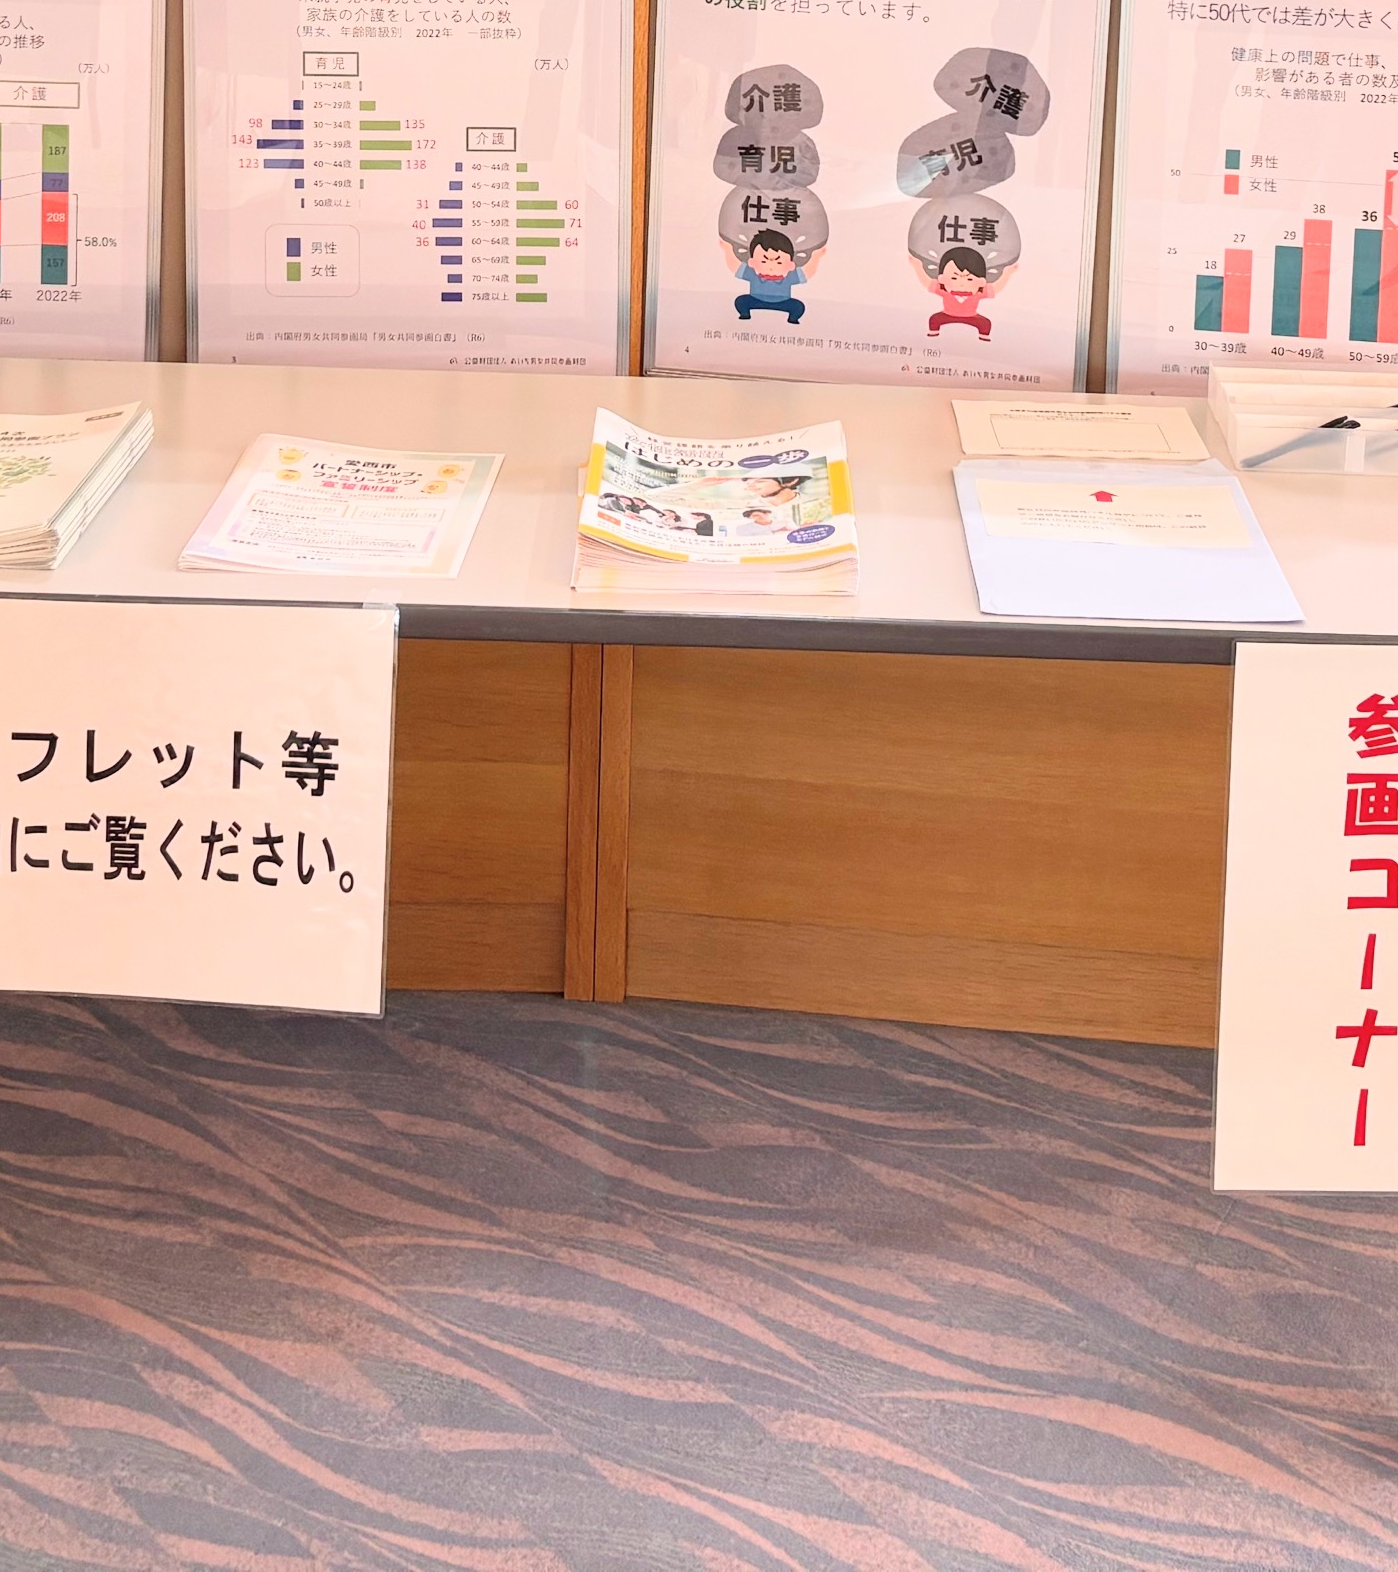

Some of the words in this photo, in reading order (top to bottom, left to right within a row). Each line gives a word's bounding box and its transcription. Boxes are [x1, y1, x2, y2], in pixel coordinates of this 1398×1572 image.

[307, 7, 512, 25] 家族の介護をしている人の数
[315, 57, 345, 70] 育児
[13, 85, 47, 103] 介護
[742, 83, 803, 113] 介護
[965, 73, 1030, 120] 介護
[249, 119, 262, 128] 98
[405, 120, 425, 129] 135
[232, 135, 253, 145] 143
[416, 140, 436, 149] 172
[475, 131, 505, 146] 介護
[738, 145, 797, 175] 育児
[919, 137, 983, 179] 育児
[1250, 155, 1278, 169] 男性
[1249, 178, 1278, 193] 女性
[46, 213, 65, 222] 208
[741, 196, 801, 226] 仕事
[1361, 210, 1378, 223] 36
[938, 215, 1000, 246] 仕事
[84, 236, 117, 248] 58.0%
[311, 242, 337, 254] 男性
[311, 265, 337, 277] 女性
